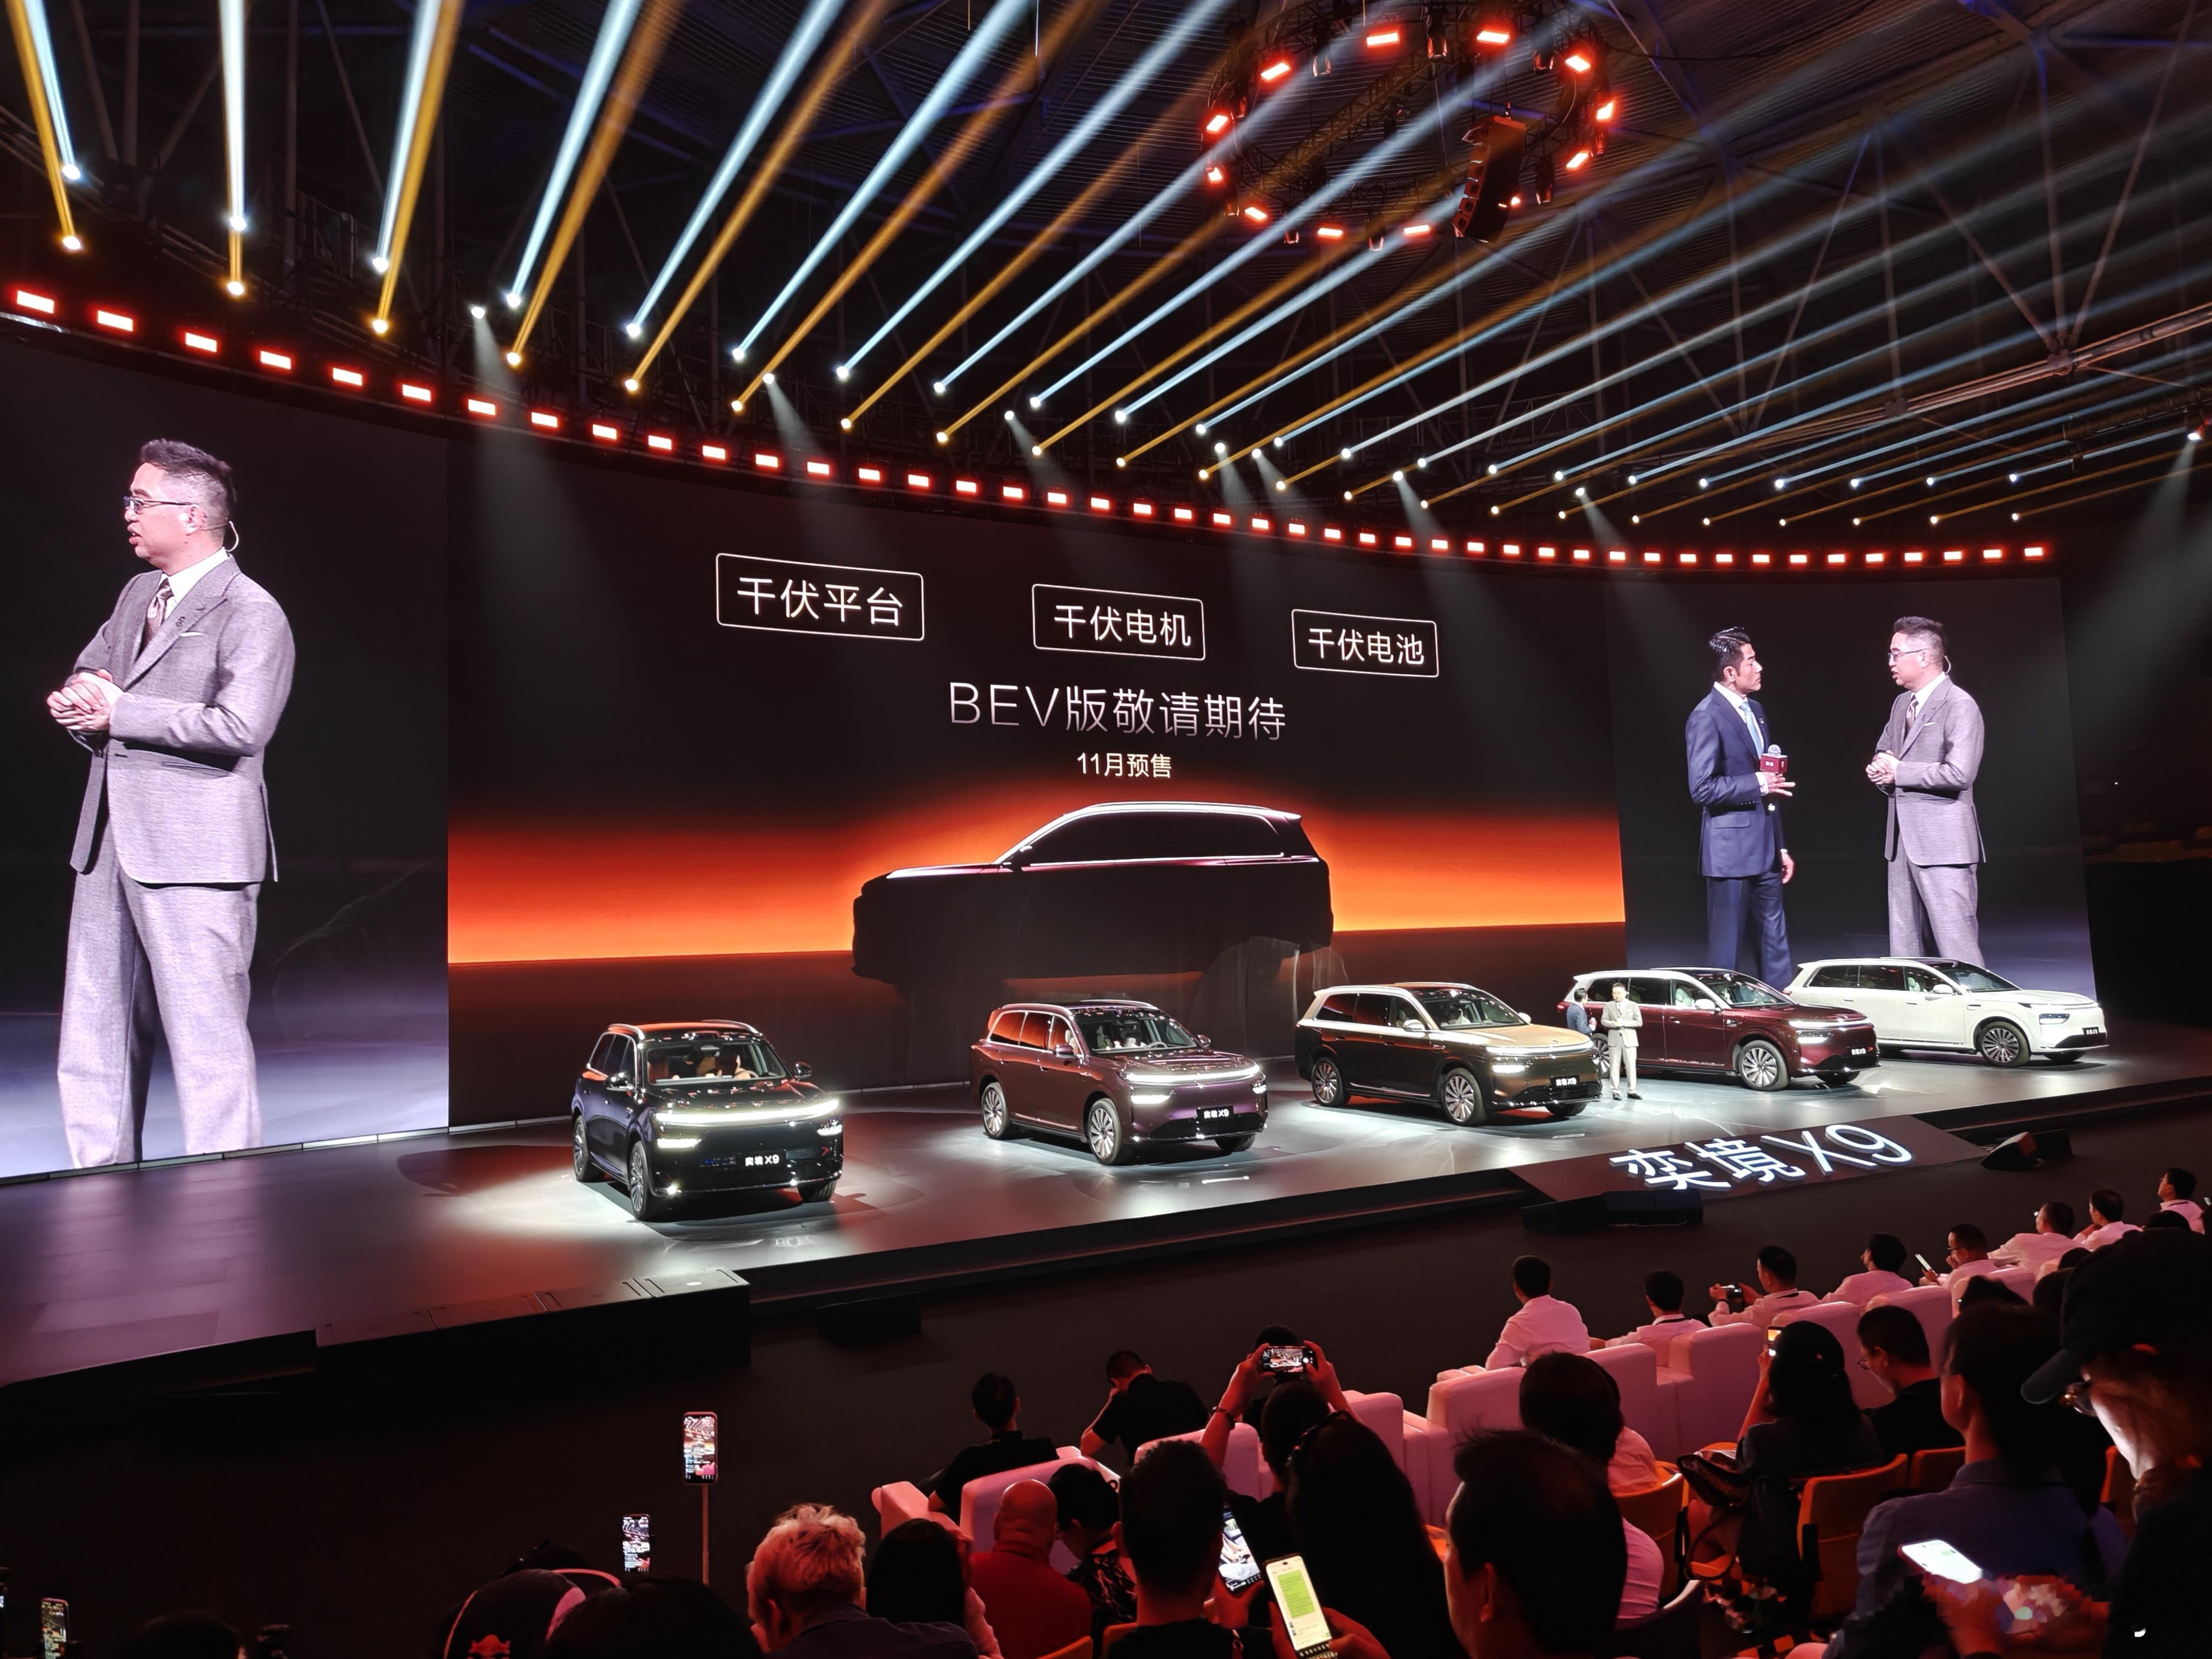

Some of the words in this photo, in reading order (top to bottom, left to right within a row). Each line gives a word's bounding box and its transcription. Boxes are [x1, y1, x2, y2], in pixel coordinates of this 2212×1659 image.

[737, 576, 903, 626] 千伏平台
[1054, 605, 1191, 646] 千伏电机
[1308, 628, 1425, 665] 千伏电池
[950, 682, 1286, 740] BEV版敬请期待
[1077, 752, 1172, 778] 11月预售
